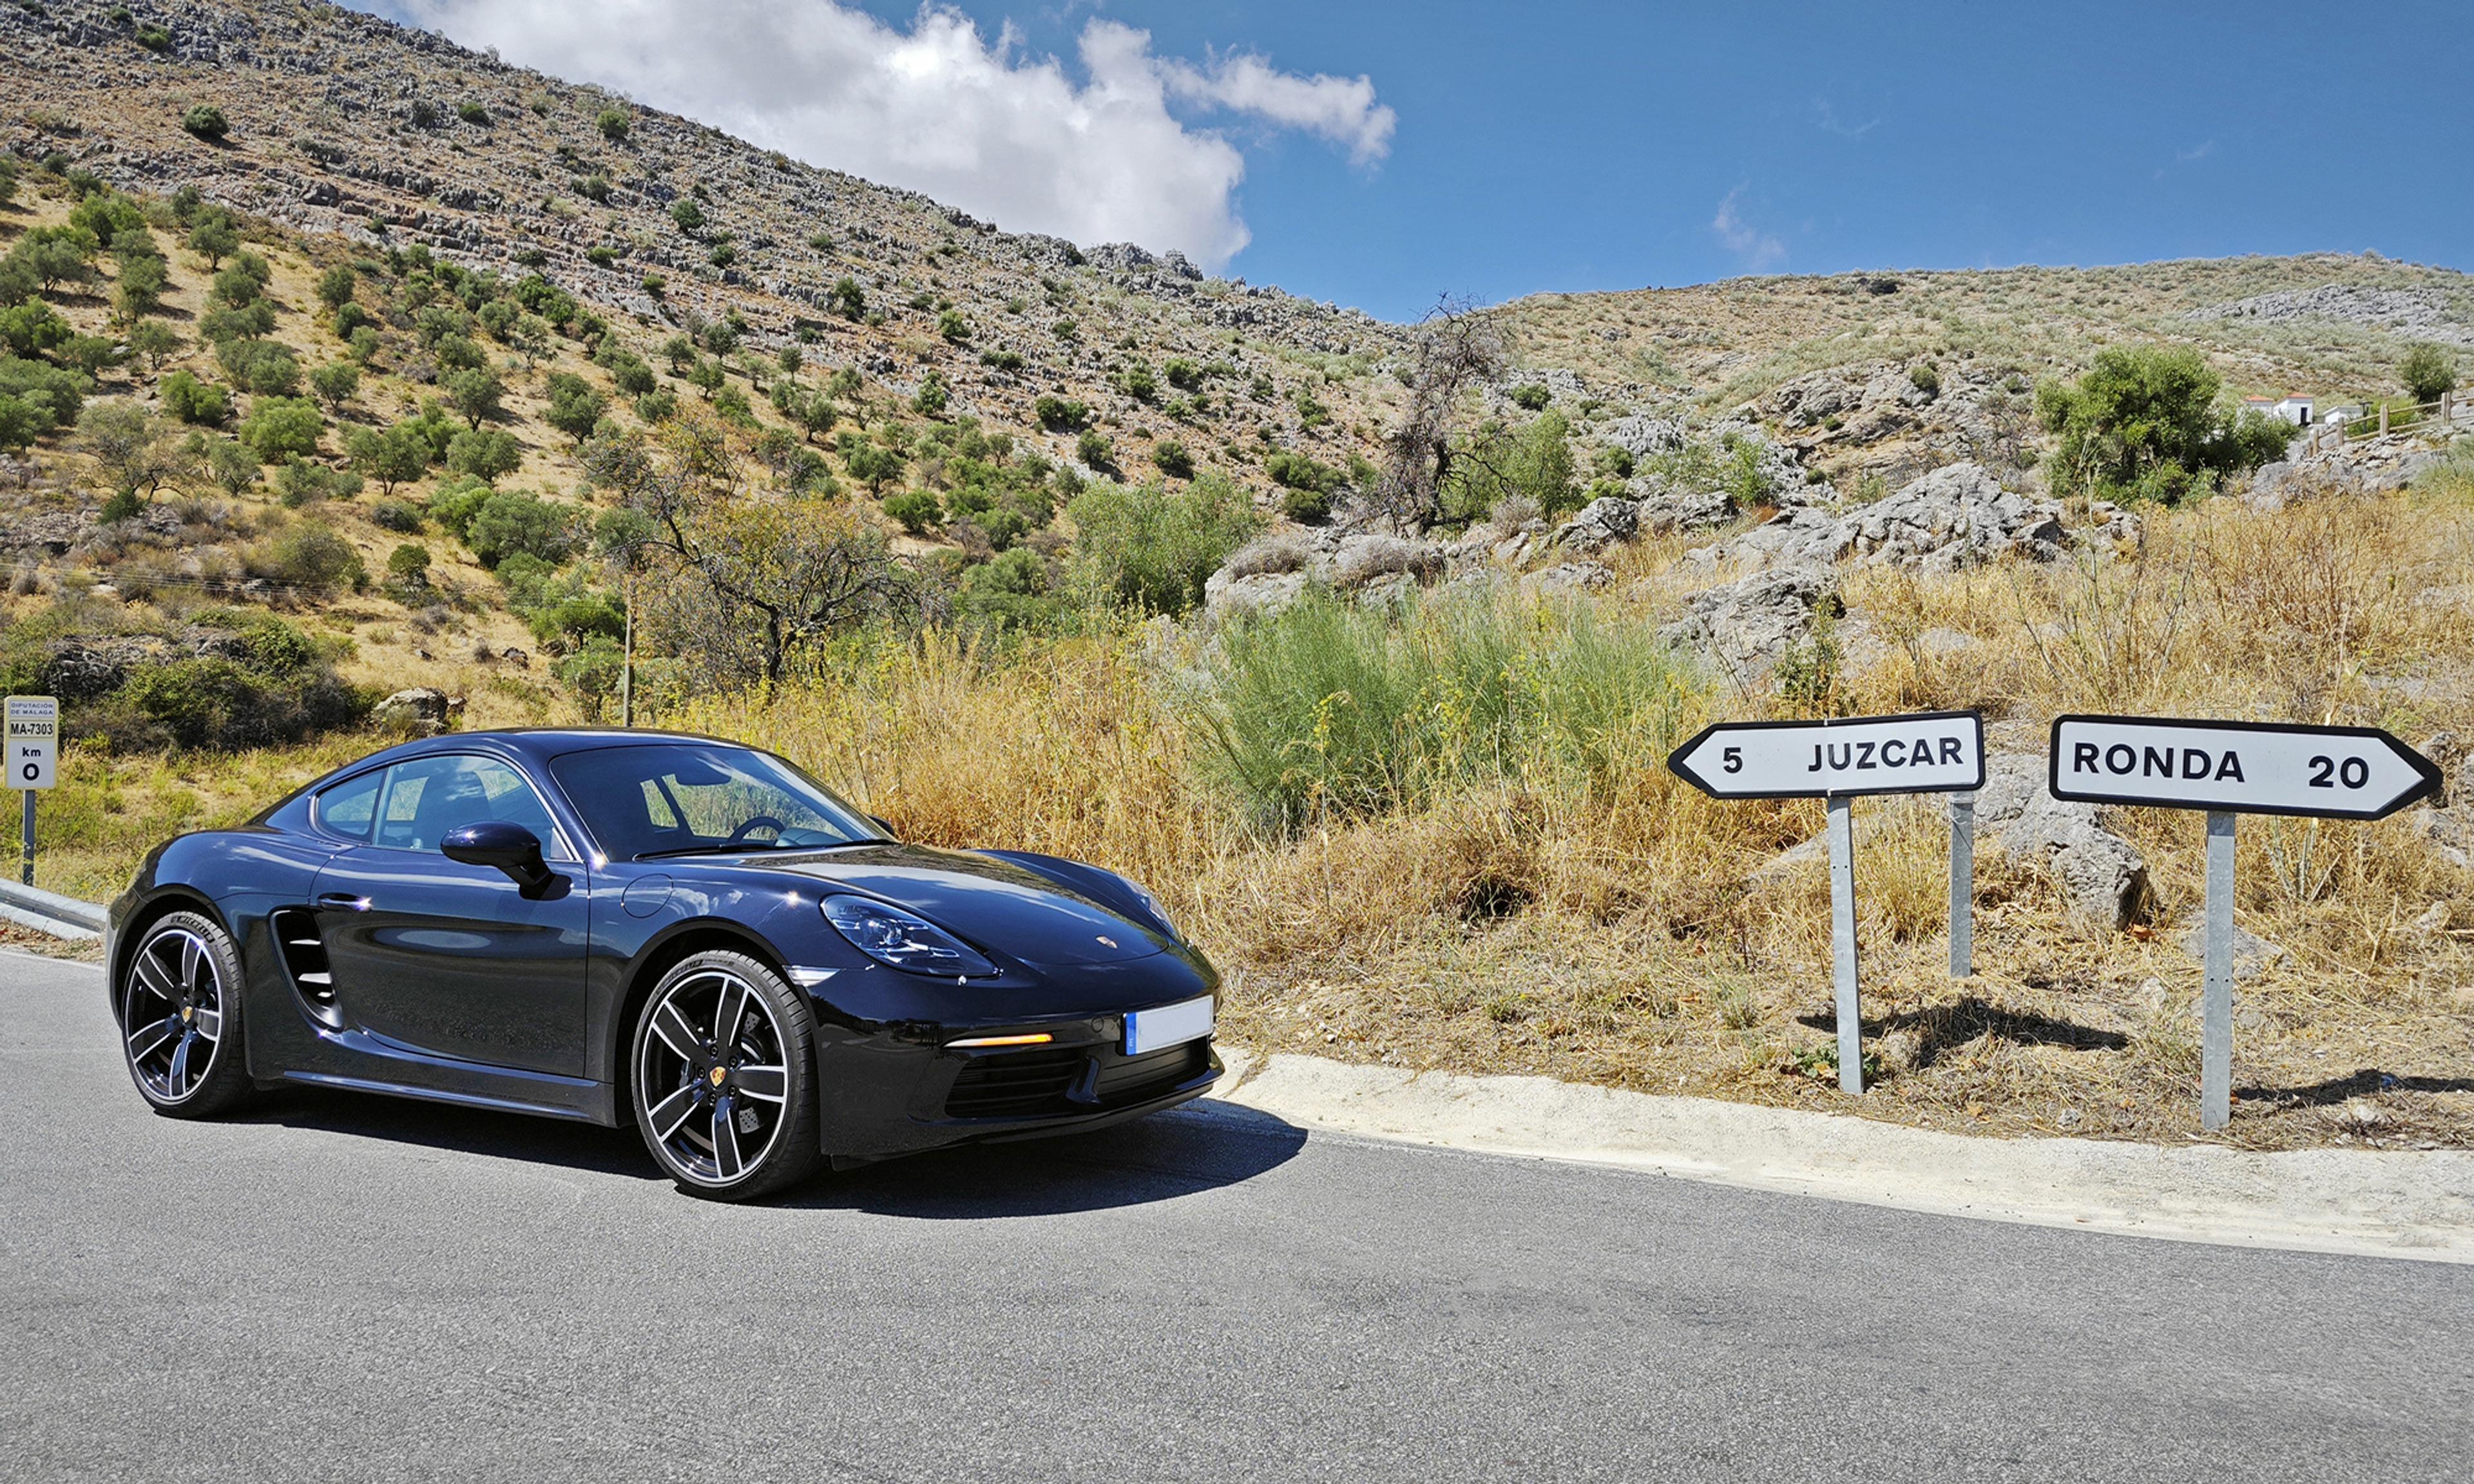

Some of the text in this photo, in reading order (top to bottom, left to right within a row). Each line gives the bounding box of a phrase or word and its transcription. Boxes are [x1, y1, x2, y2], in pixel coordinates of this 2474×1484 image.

[10, 723, 53, 735] MA-7303
[22, 747, 41, 757] km
[1723, 737, 1963, 773] 5 JUZCAR
[2073, 742, 2369, 789] RONDA 20
